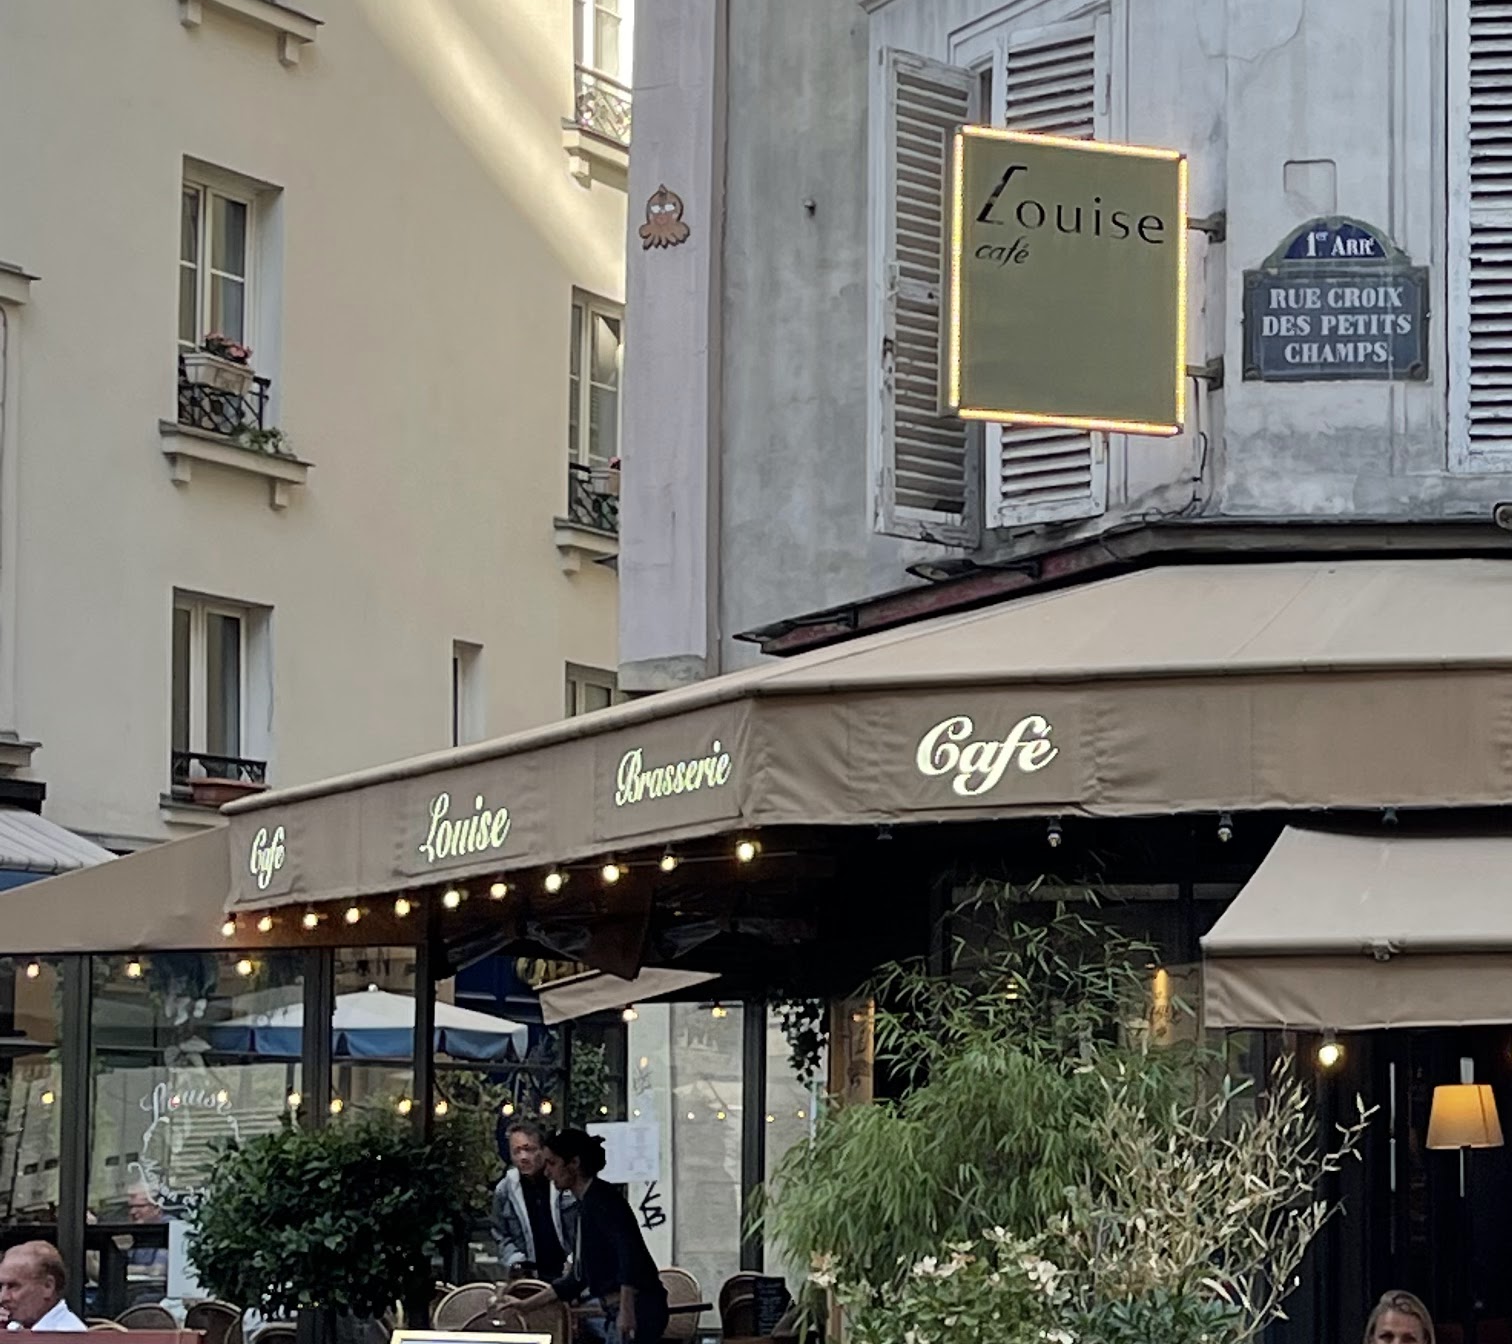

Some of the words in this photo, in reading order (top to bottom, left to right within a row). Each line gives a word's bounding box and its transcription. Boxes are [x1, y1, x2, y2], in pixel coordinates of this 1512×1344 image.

[976, 165, 1165, 244] Louise
[975, 235, 1030, 266] café
[1262, 315, 1311, 337] DES
[1320, 314, 1412, 336] PETITS
[1269, 288, 1321, 309] RUE
[1327, 287, 1404, 309] CROIX
[916, 714, 1060, 797] Café
[419, 792, 511, 862] Louise
[615, 740, 732, 806] Brasserie
